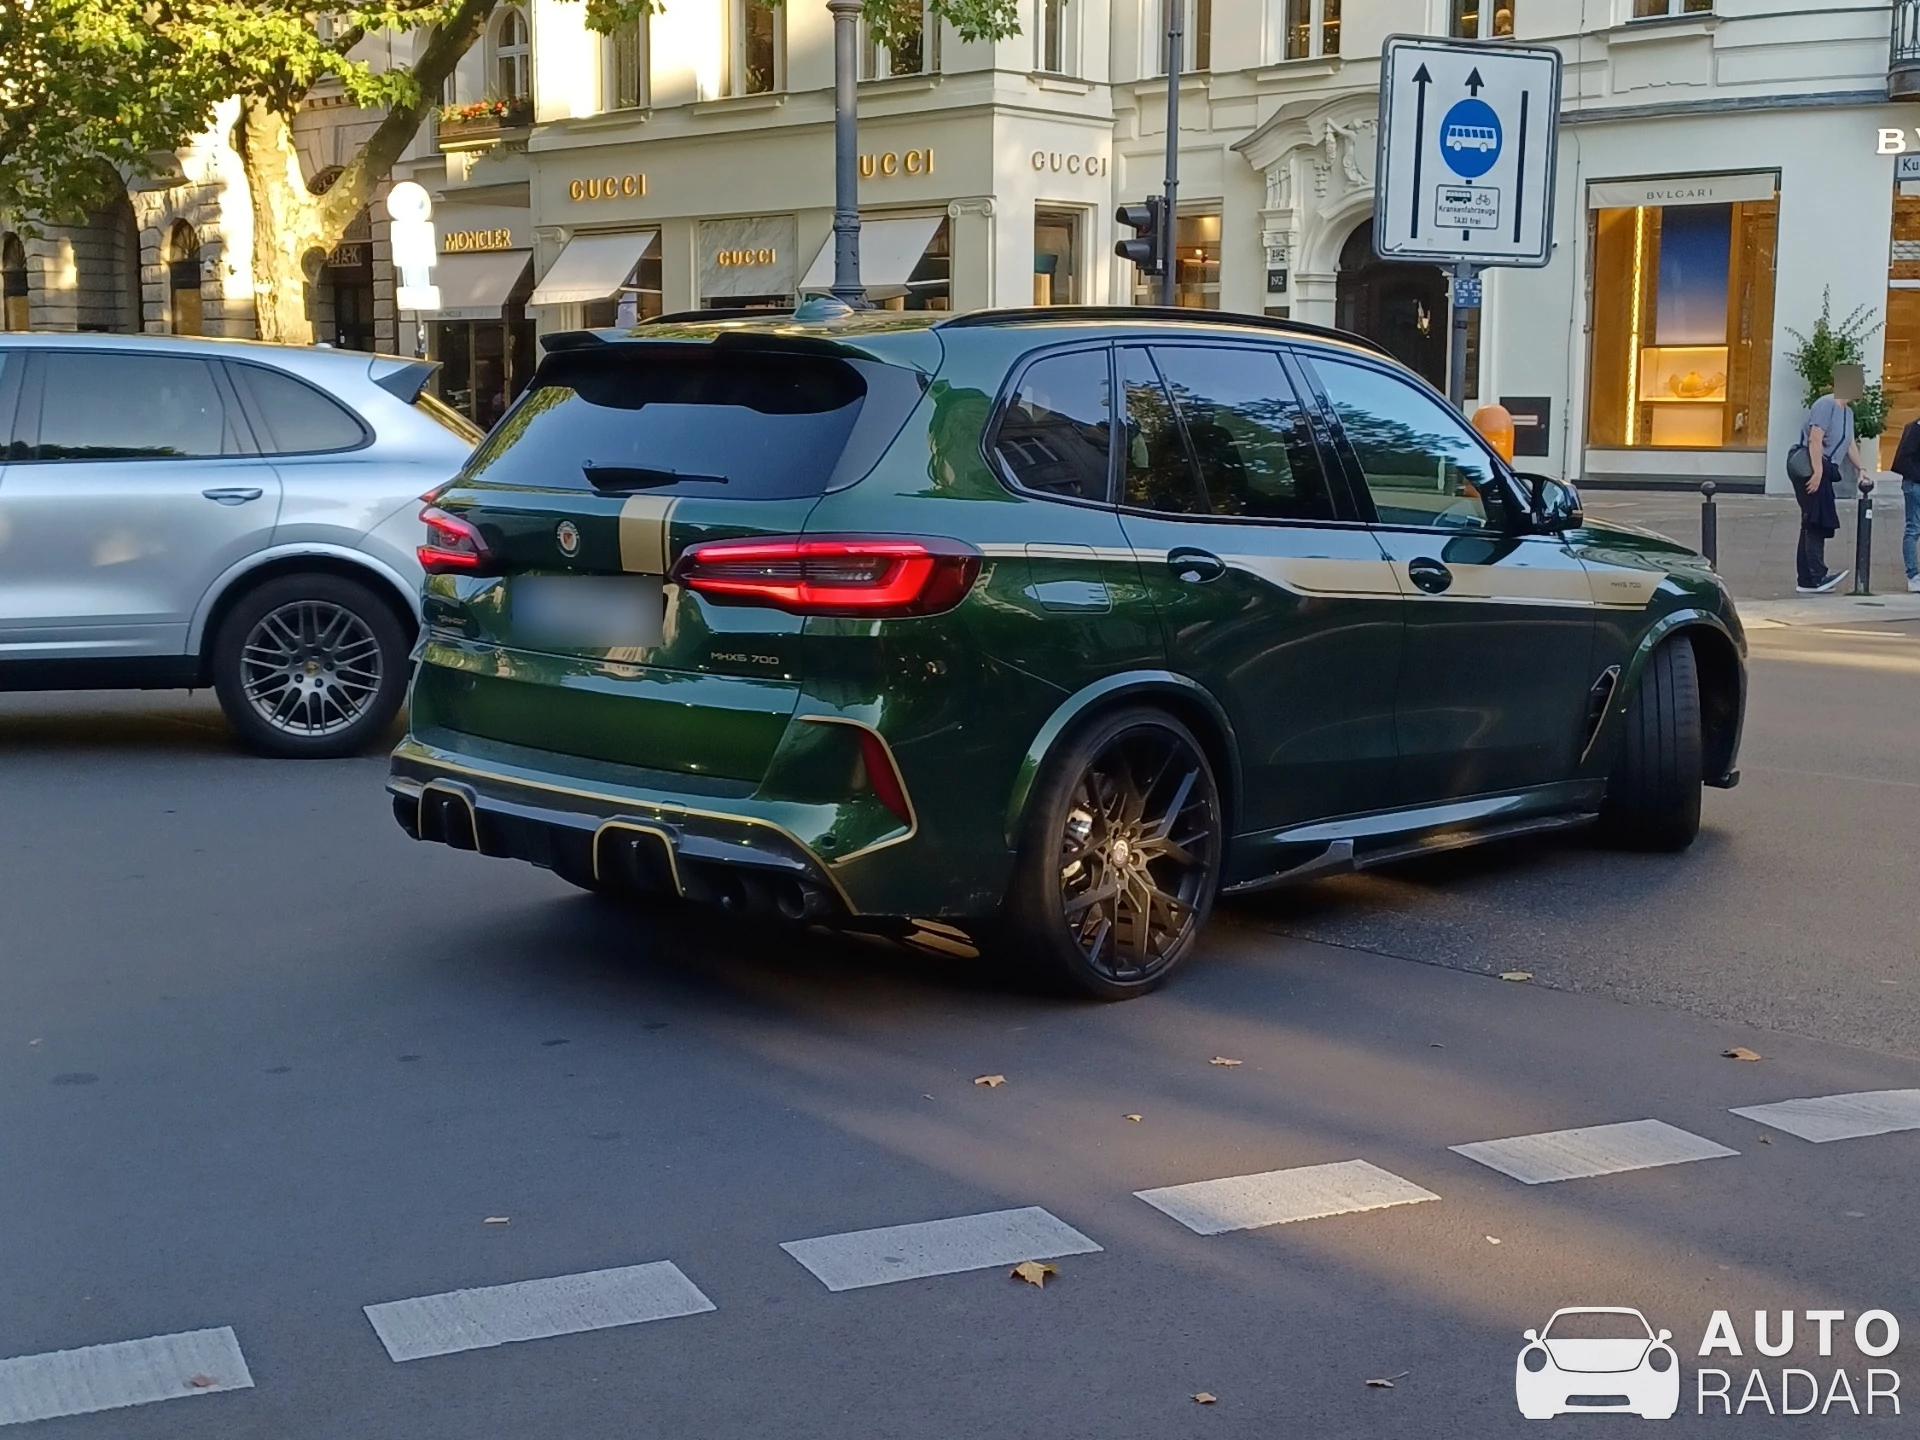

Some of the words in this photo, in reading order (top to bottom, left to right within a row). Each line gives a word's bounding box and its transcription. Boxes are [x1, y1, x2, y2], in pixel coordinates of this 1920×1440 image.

[1877, 128, 1920, 154] B
[859, 148, 934, 178] UCCI
[1032, 150, 1107, 177] GUCCI
[569, 173, 647, 201] GUCCI
[1646, 188, 1713, 200] BVLGARI
[1438, 205, 1496, 216] Krankenfahrzeuge
[1453, 216, 1468, 224] TAXI
[1469, 217, 1482, 225] frei
[444, 228, 512, 251] MONCLER
[717, 248, 776, 266] GUCCI
[1271, 275, 1284, 286] 192
[751, 654, 779, 665] 700
